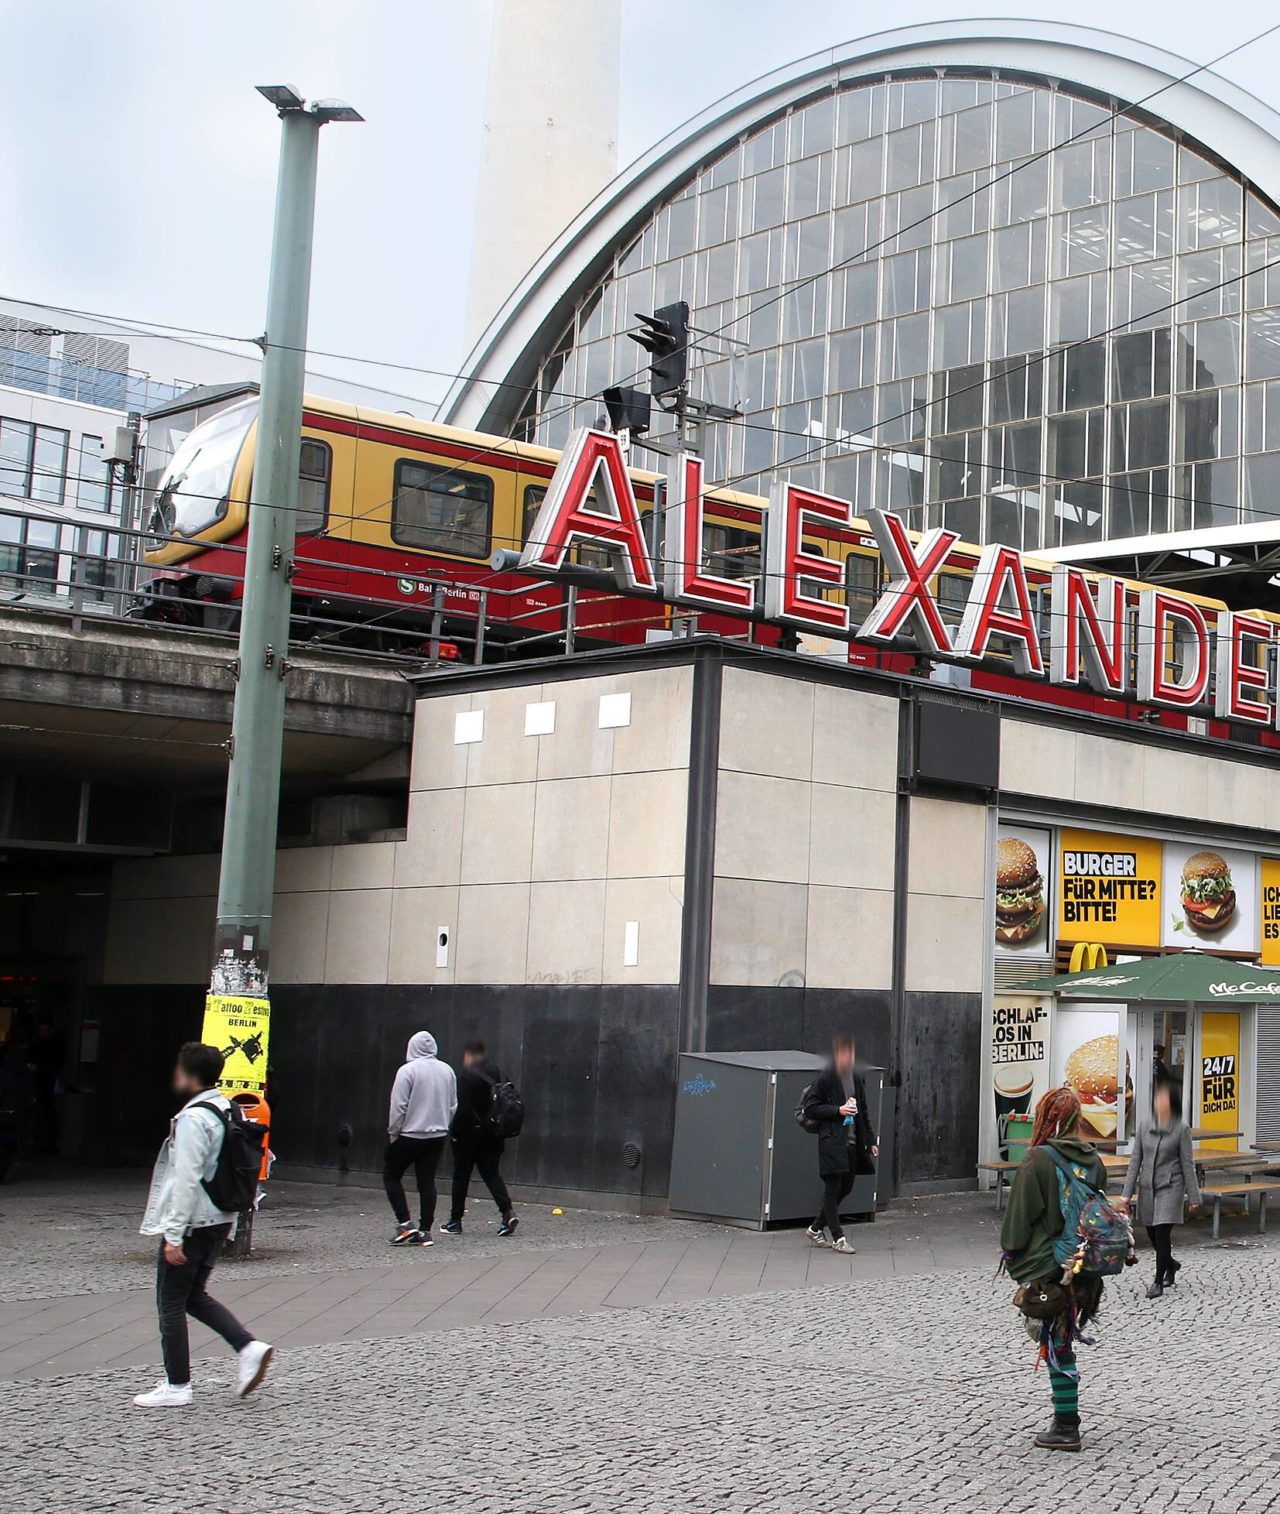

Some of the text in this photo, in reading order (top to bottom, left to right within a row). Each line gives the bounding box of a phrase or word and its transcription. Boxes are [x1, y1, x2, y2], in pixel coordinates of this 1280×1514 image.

[1063, 853, 1135, 876] BURGER
[1099, 880, 1156, 900] MITTE?
[1063, 901, 1117, 922] BITTE!
[228, 1018, 257, 1028] BERLIN
[992, 1025, 1032, 1043] OS IN
[992, 1043, 1044, 1063] BERLIN:
[1203, 1056, 1234, 1075] 24/7
[1203, 1101, 1236, 1114] DICH DA!
